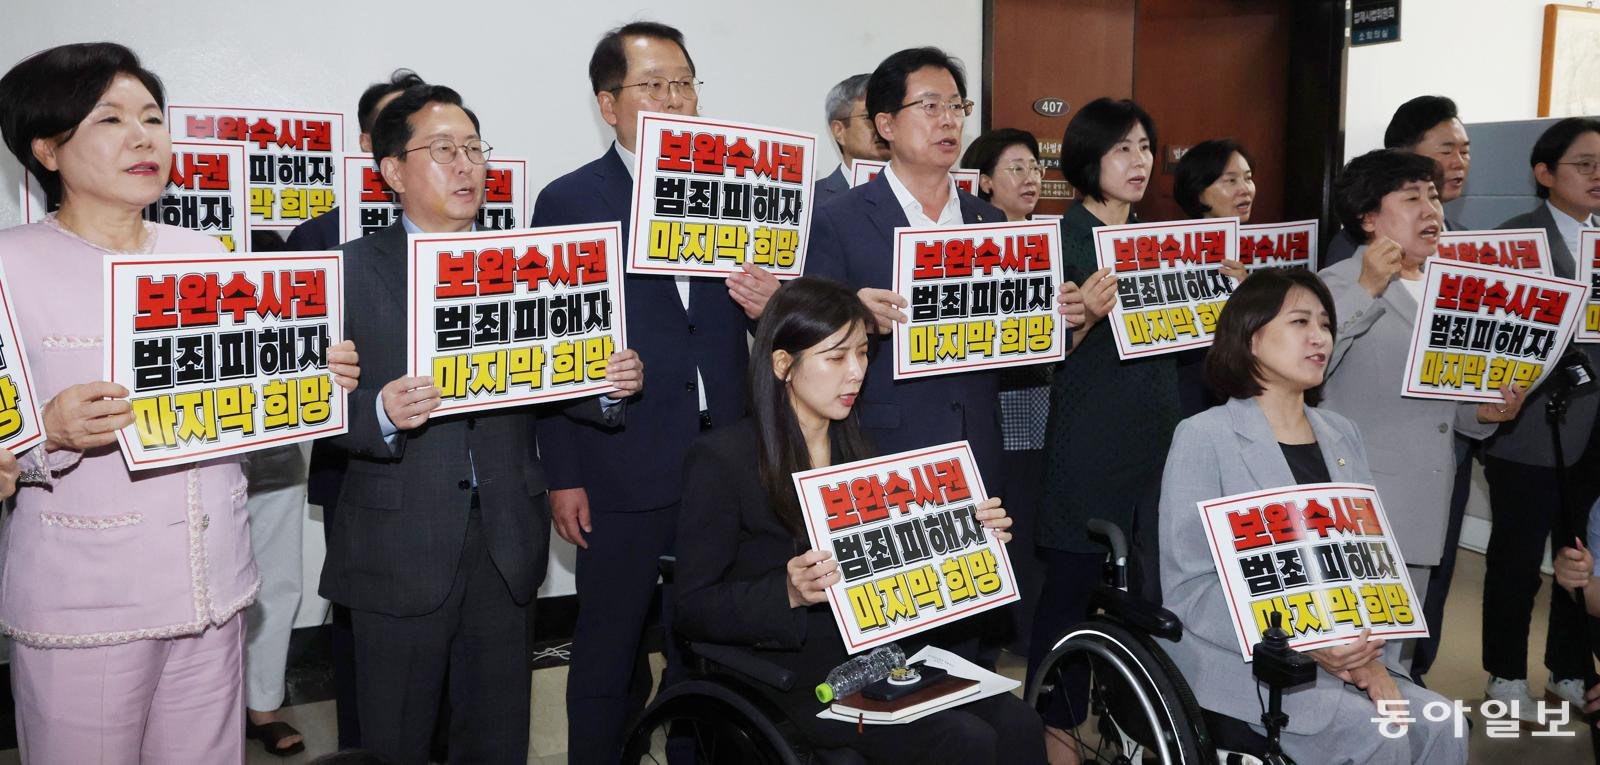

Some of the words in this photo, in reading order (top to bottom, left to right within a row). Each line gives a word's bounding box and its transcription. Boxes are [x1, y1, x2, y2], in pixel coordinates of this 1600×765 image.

[186, 114, 332, 152] 보완수사권
[1041, 101, 1063, 113] 407
[250, 153, 335, 186] 피해자
[656, 129, 804, 184] 보완수사권
[434, 240, 608, 299] 보완수사권
[648, 220, 749, 266] 마지막
[752, 226, 800, 268] 희망
[912, 231, 1051, 281] 보완수사권
[1113, 231, 1226, 272] 보완수사권
[1240, 231, 1309, 264] 완수사권
[133, 268, 328, 333] 보완수사권
[1123, 305, 1199, 345] 마지막
[1196, 301, 1227, 335] 희
[1435, 273, 1570, 326] 보완수사권
[908, 314, 996, 366] 마지막
[999, 314, 1055, 355] 희망
[431, 344, 546, 400] 마지막
[551, 337, 615, 385] 희망
[1420, 351, 1487, 391] 마지막
[1487, 357, 1544, 391] 희망
[130, 386, 257, 450] 마지막
[262, 374, 334, 430] 희망
[818, 457, 973, 534] 보완수사권
[1226, 496, 1385, 553] 보완수사권
[845, 565, 947, 633] 마지막
[942, 548, 1003, 603] 희망
[1250, 585, 1364, 640] 마지막
[1360, 583, 1415, 626] 희망
